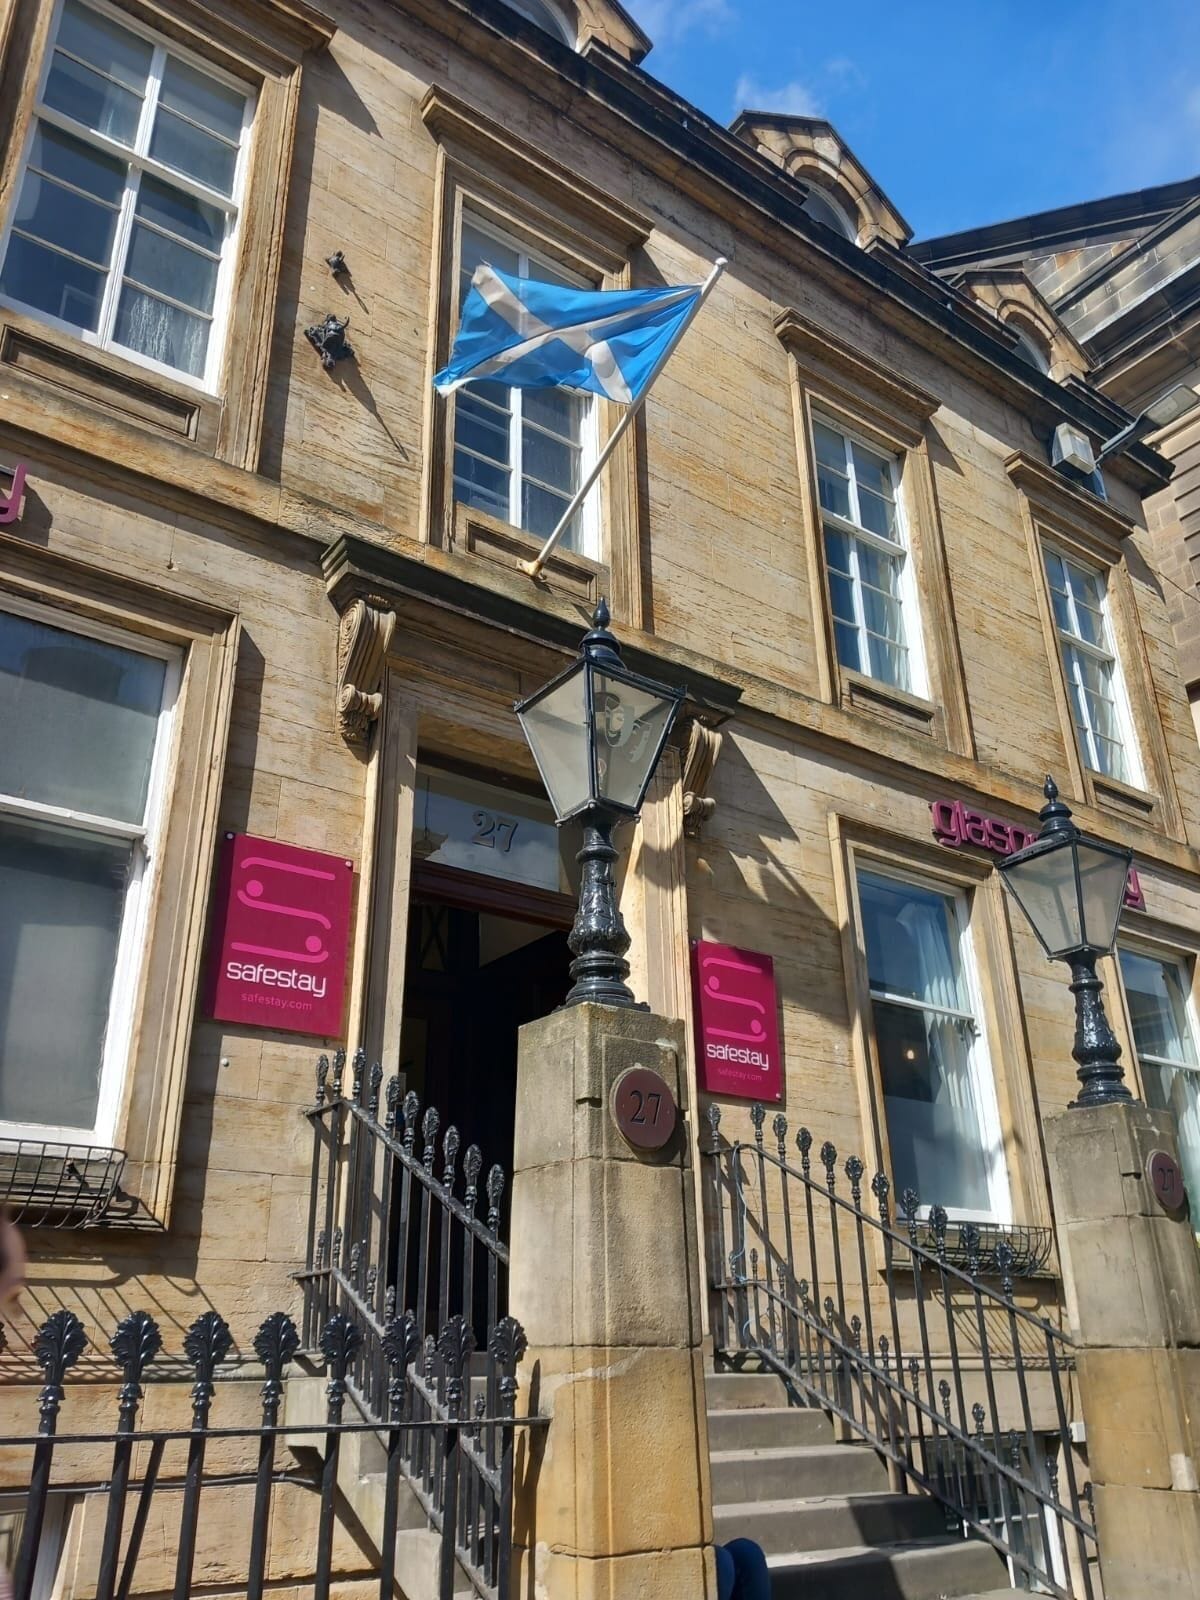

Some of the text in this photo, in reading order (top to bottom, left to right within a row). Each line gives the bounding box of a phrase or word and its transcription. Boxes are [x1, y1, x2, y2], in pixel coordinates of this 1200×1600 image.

[471, 810, 519, 853] 27
[226, 962, 326, 998] safestay
[241, 991, 312, 1011] safestay.com
[706, 1043, 769, 1071] safestay
[630, 1089, 662, 1126] 27
[1158, 1167, 1175, 1193] 27
